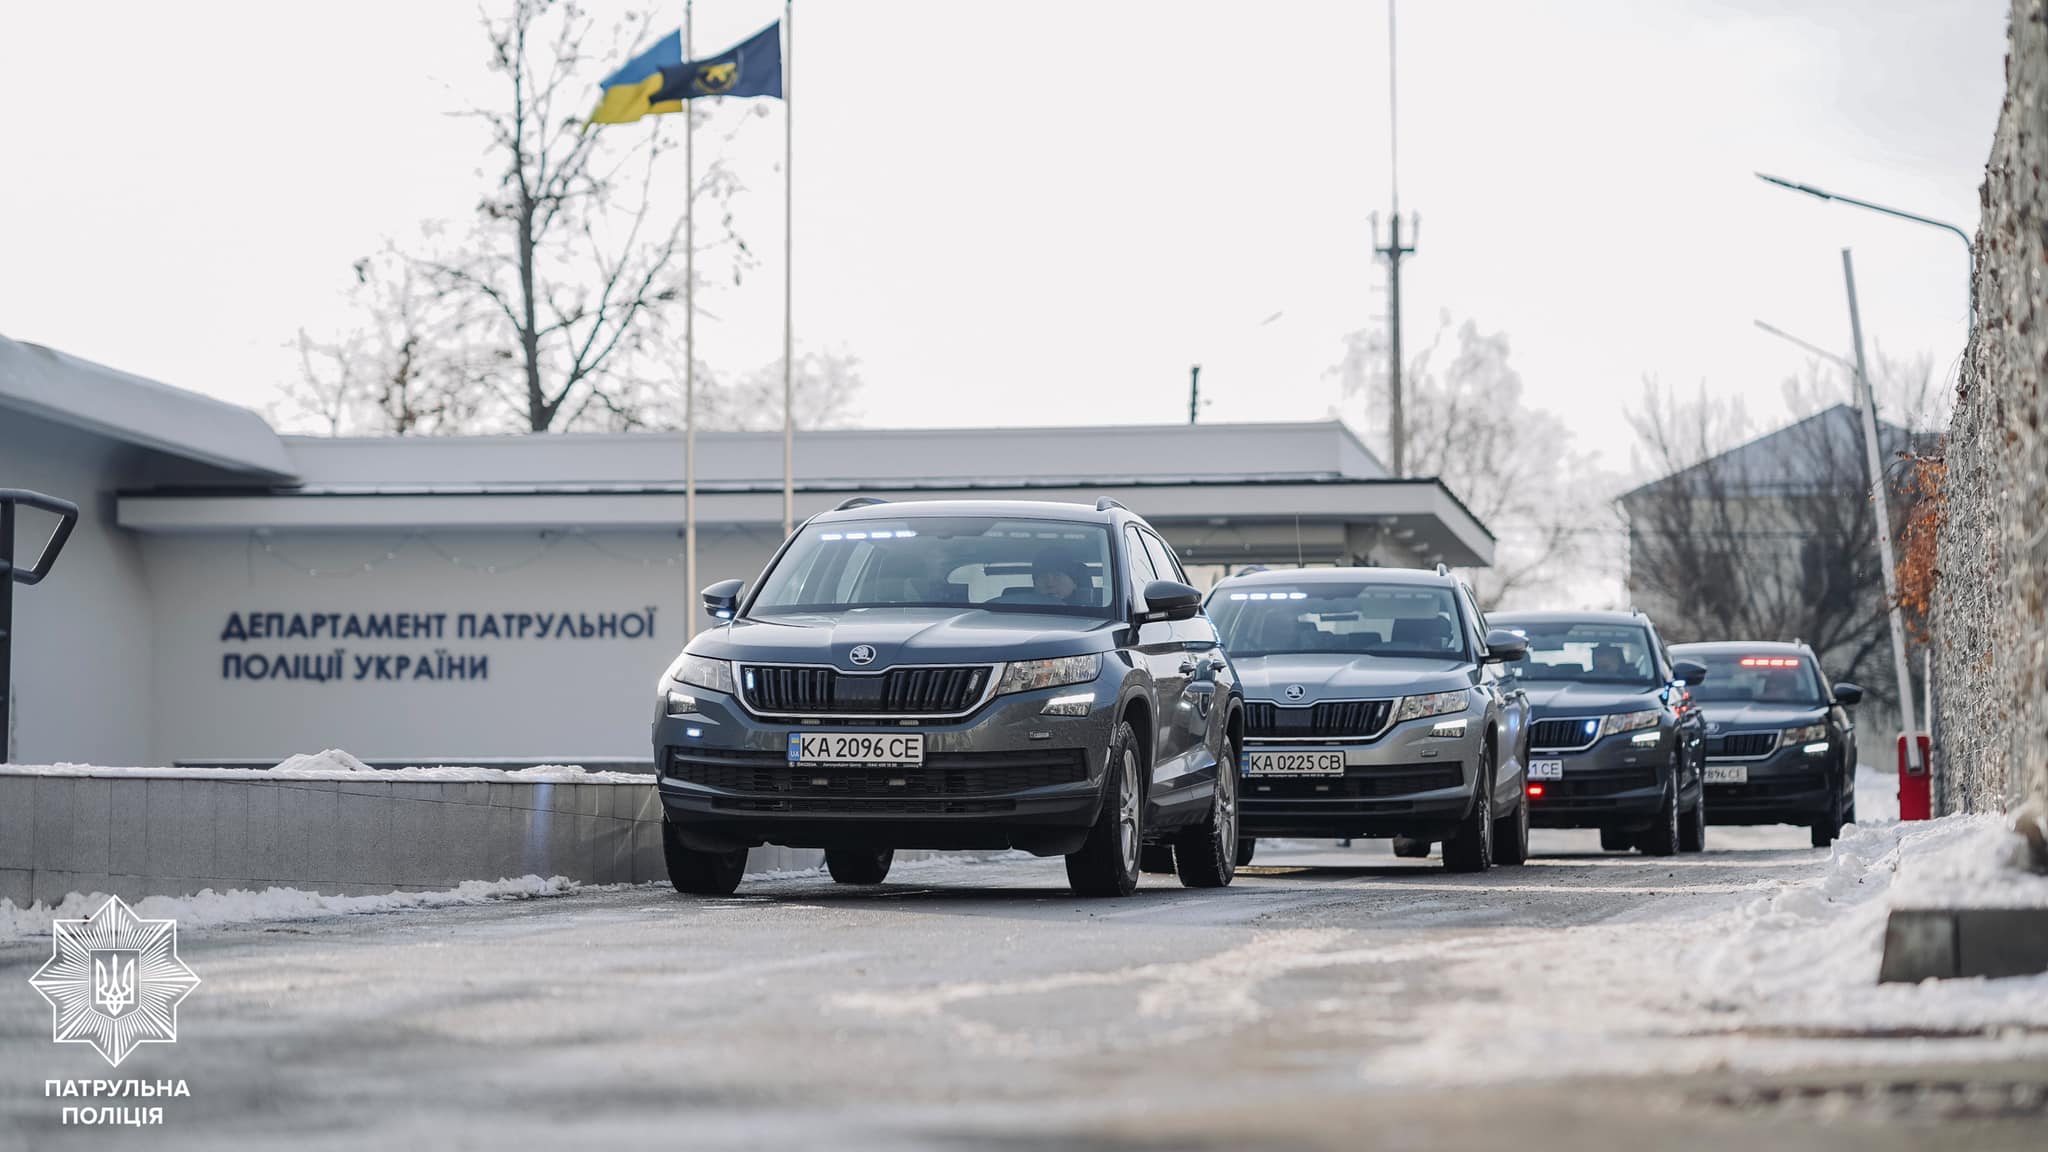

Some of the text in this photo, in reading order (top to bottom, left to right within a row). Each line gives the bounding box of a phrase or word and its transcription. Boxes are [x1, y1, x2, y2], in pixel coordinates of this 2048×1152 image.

[221, 606, 657, 641] ДЕПАРТАМЕНТ ПАТРУЛЬНОЇ
[222, 648, 488, 682] ПОЛІЦІЇ УКРАЇНИ
[801, 737, 920, 759] KA 2096 CE
[1250, 755, 1274, 771] KA
[1277, 755, 1315, 771] 0225
[1318, 755, 1341, 770] CB
